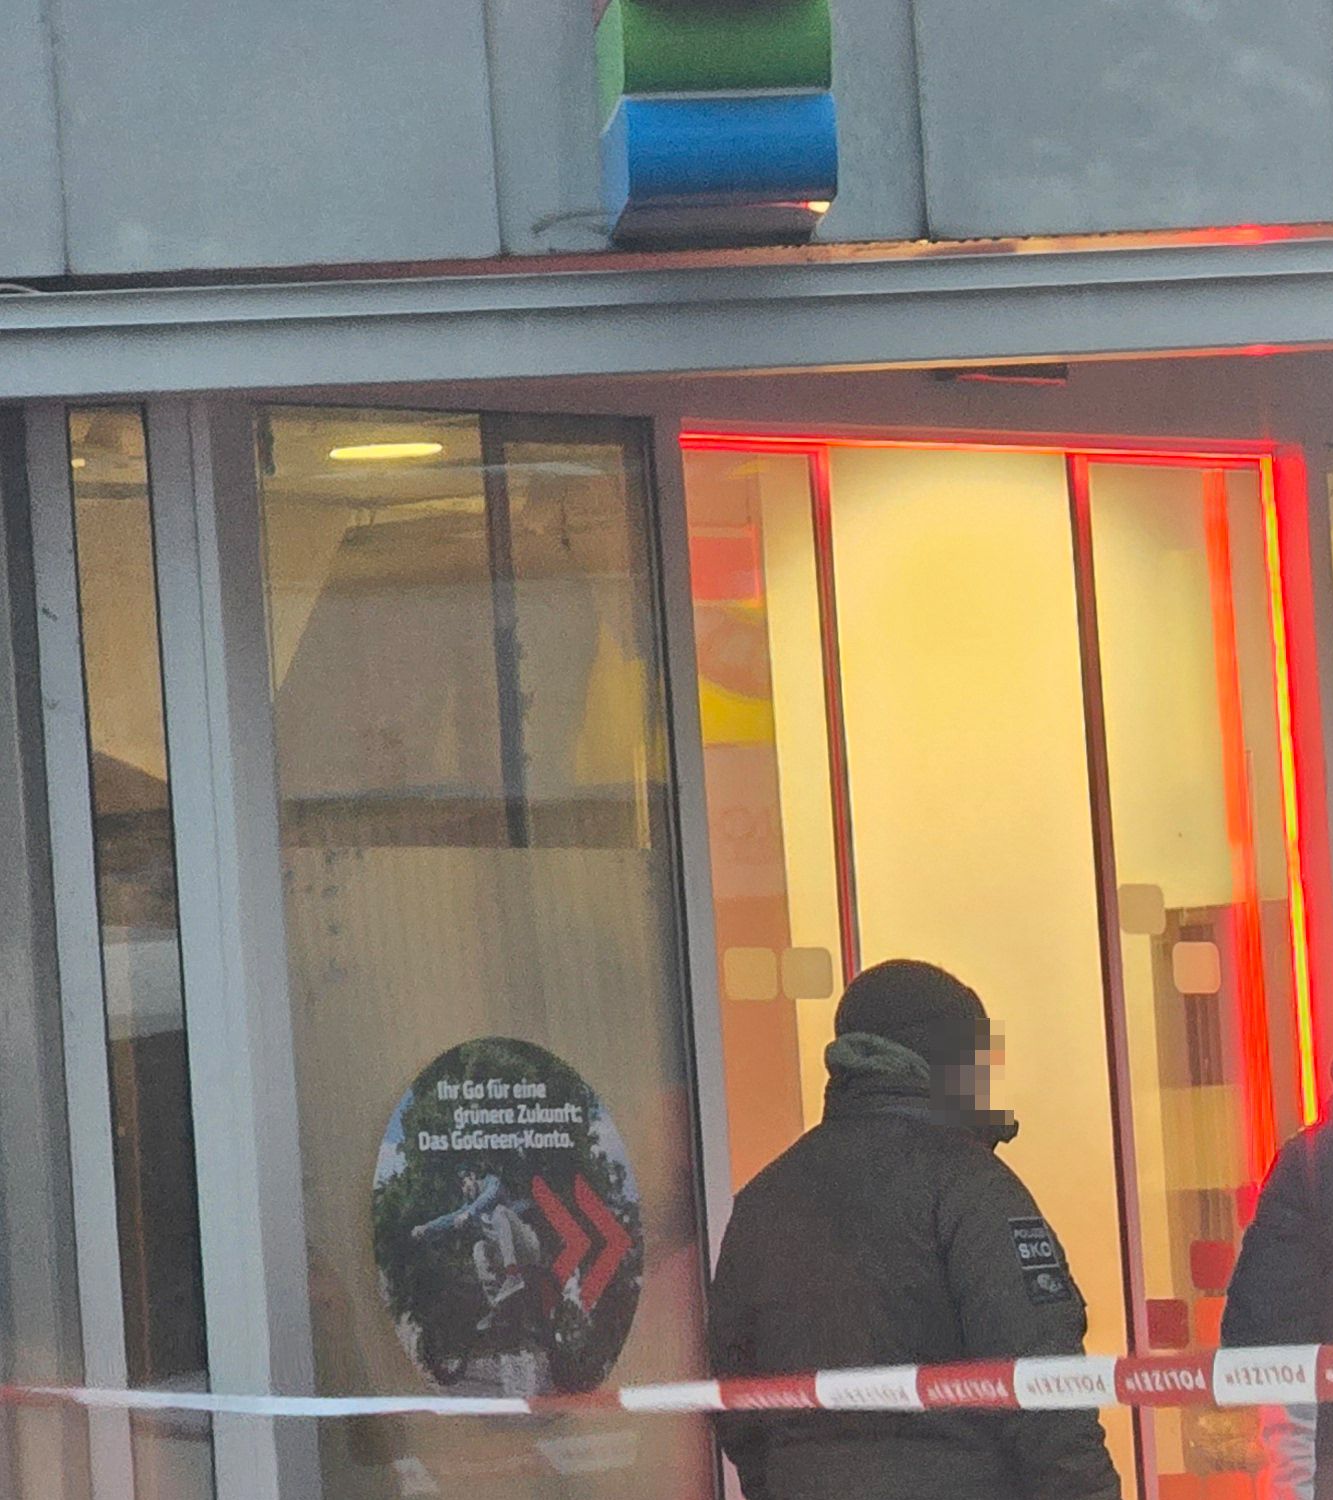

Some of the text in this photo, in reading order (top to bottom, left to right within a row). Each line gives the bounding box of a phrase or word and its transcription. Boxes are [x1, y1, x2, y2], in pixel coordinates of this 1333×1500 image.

[437, 1077, 547, 1100] Ihr Go für eine
[454, 1103, 514, 1129] grünere
[418, 1131, 449, 1151] Das
[1135, 1367, 1206, 1391] POLIZEI
[1235, 1363, 1306, 1386] POLIZEI
